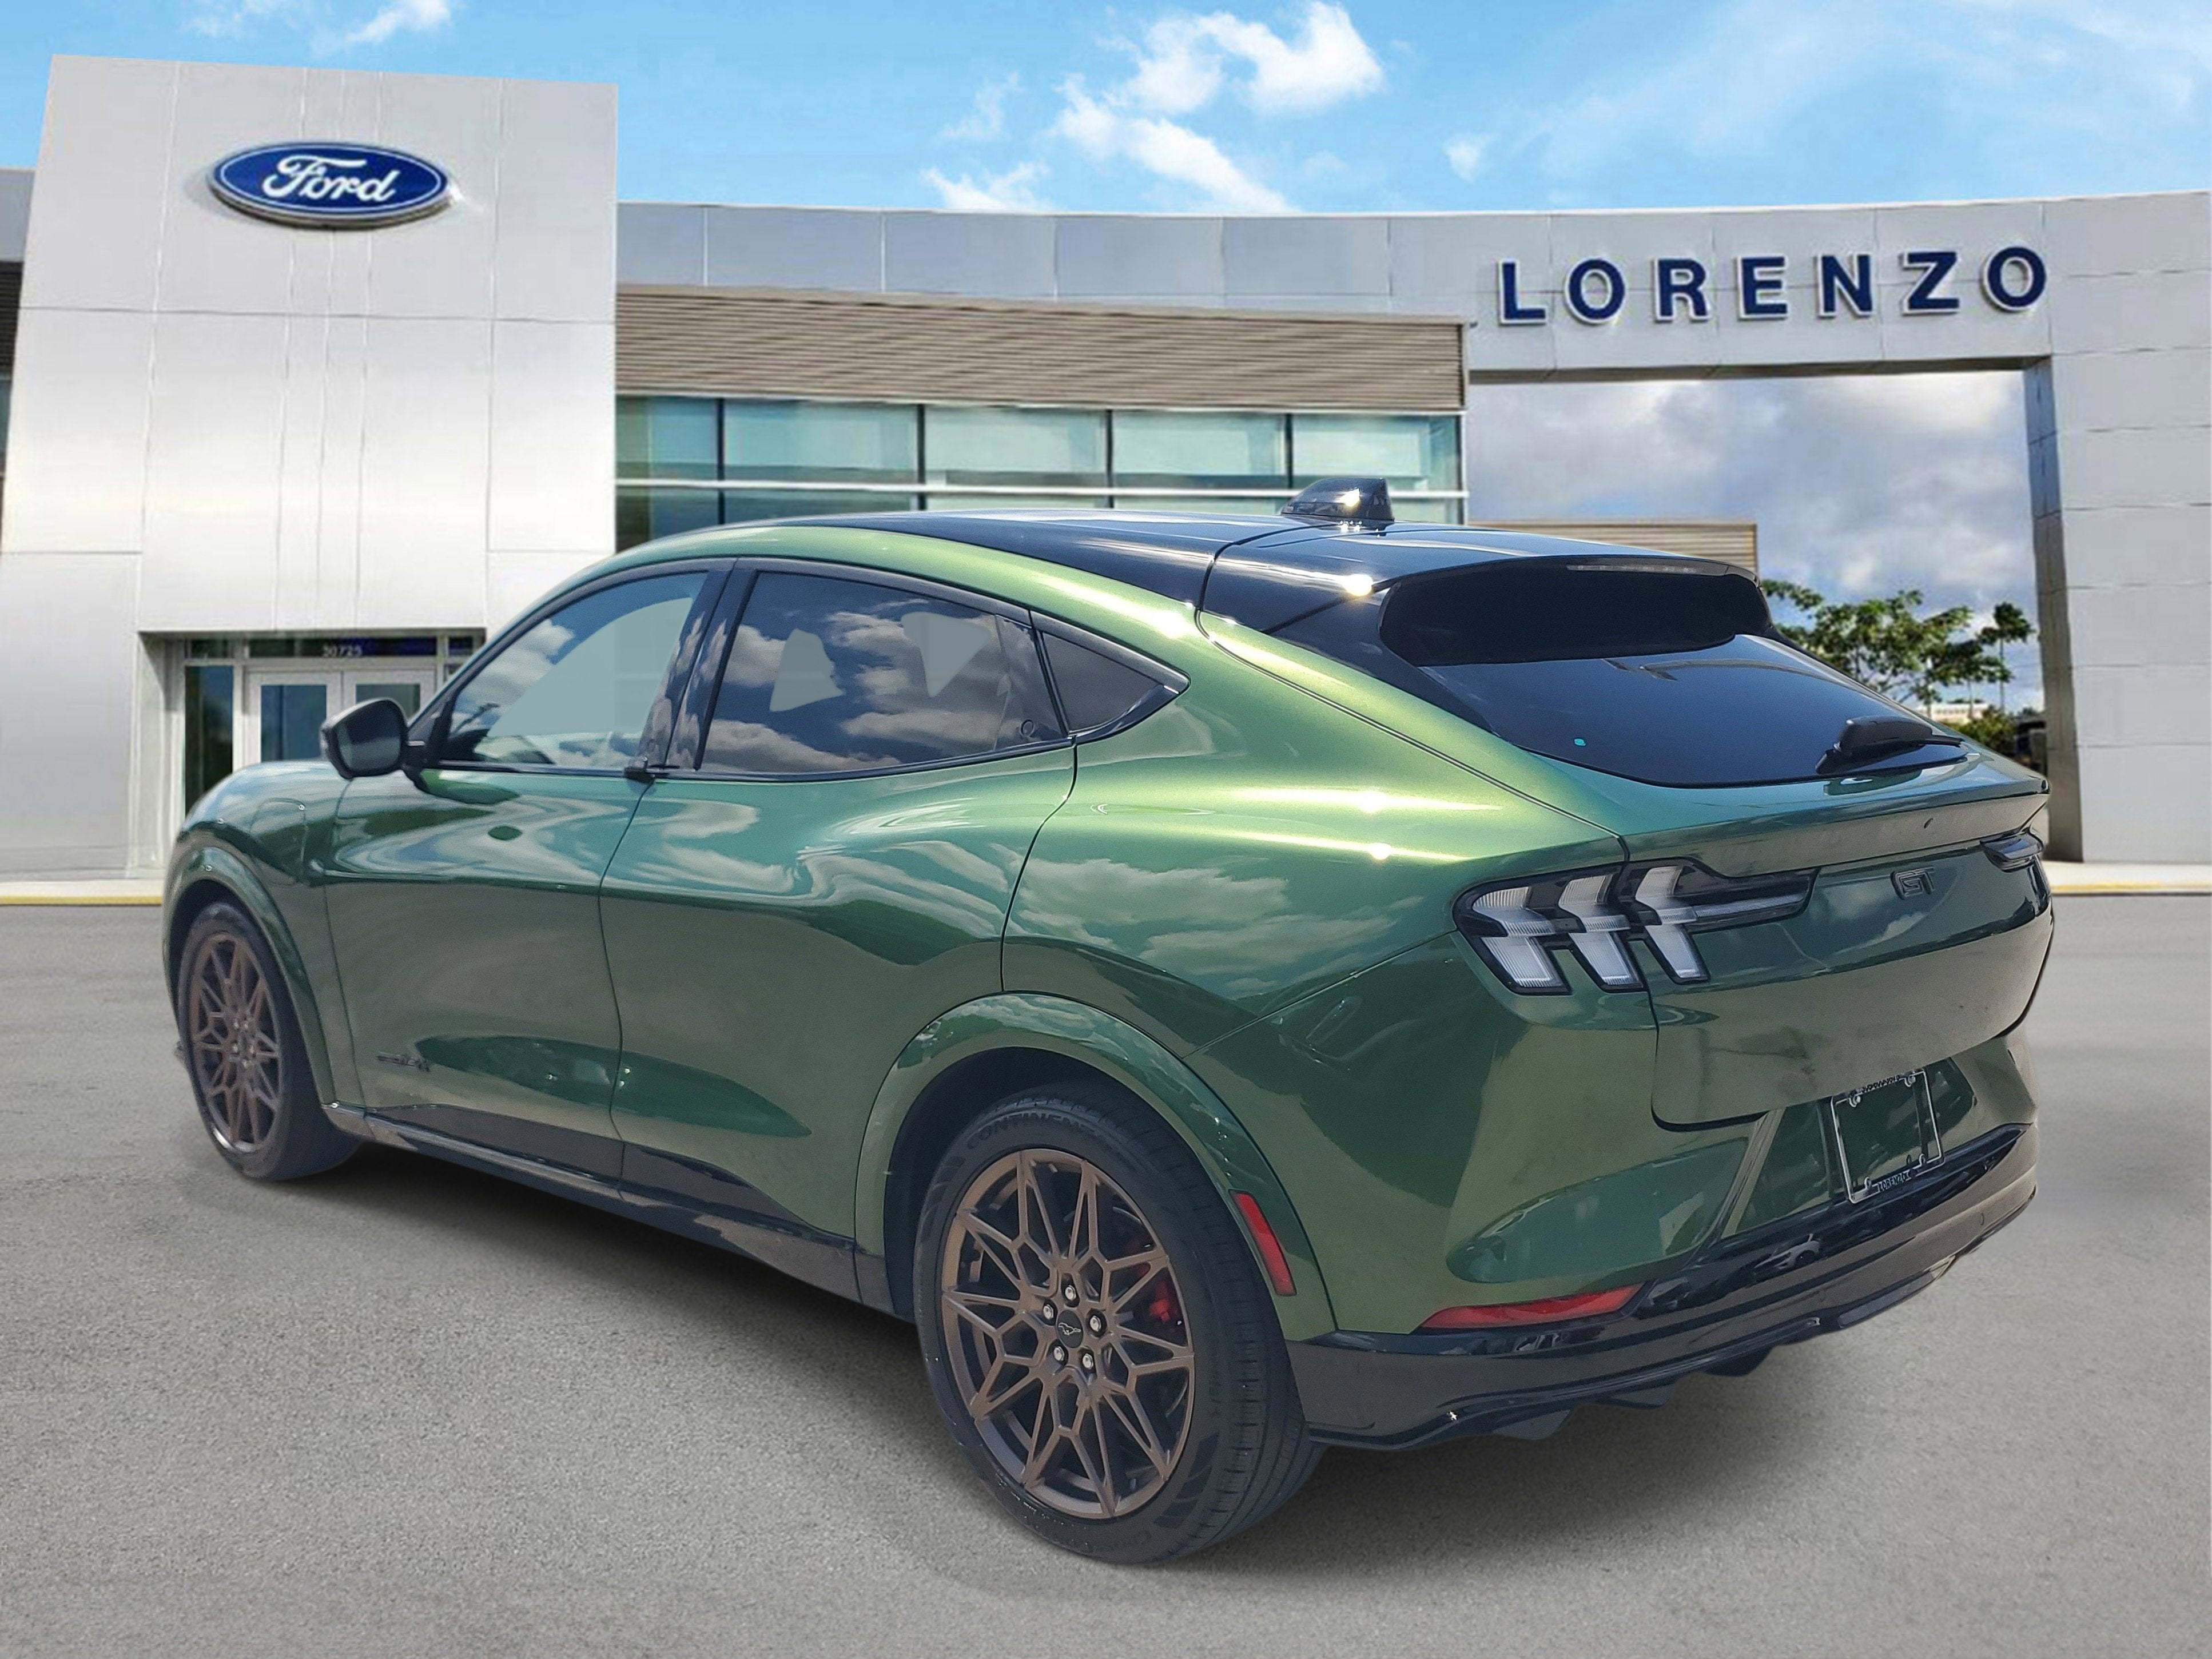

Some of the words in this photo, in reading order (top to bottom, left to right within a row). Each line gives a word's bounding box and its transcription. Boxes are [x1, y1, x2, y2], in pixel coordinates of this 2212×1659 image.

[262, 154, 400, 202] Ford
[1499, 246, 2047, 324] LORENZO
[1891, 866, 1934, 900] GT
